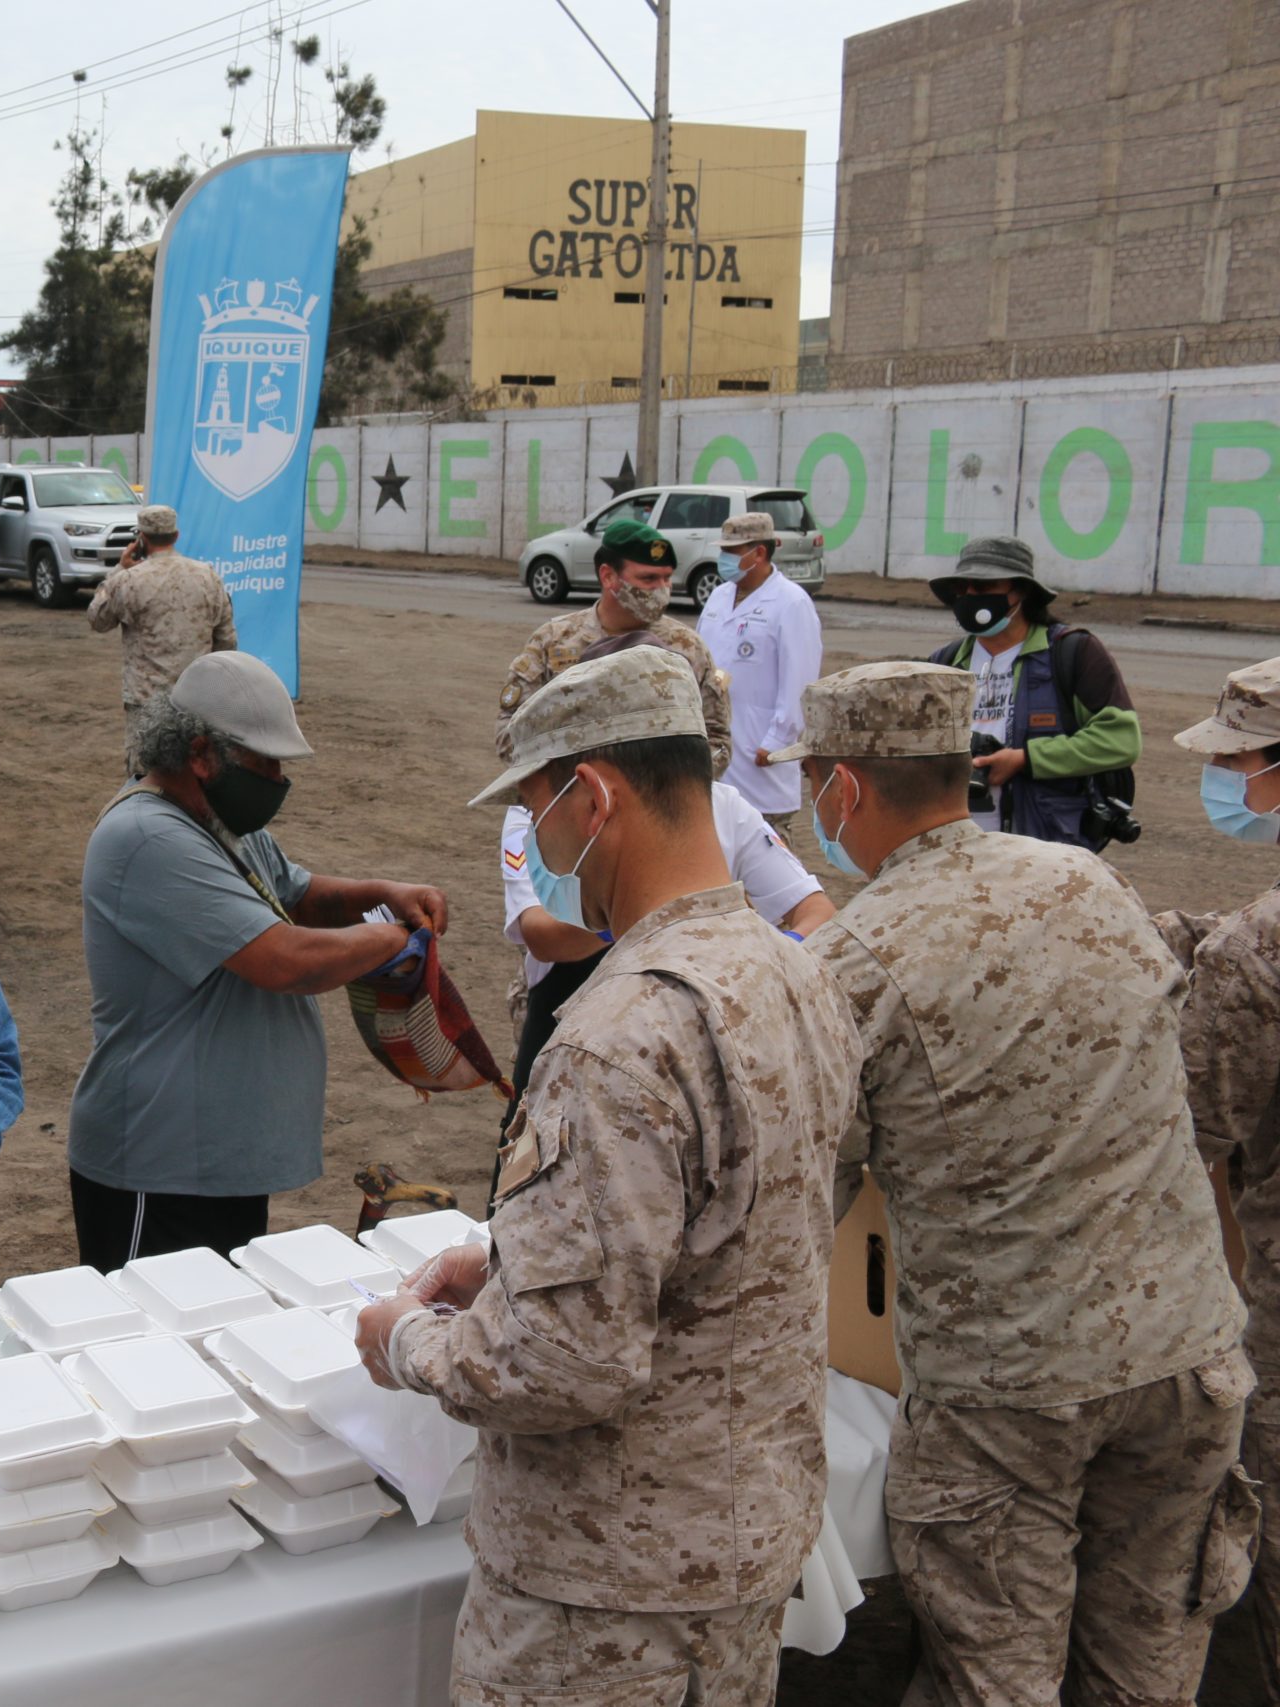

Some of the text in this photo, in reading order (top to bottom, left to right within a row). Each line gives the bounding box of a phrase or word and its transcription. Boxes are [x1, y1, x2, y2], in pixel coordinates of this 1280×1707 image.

[568, 178, 696, 229] SUPR
[529, 230, 740, 282] GATO TDA
[205, 341, 301, 356] IQUIQUE
[232, 534, 287, 553] Ilustre
[224, 575, 284, 596] quique
